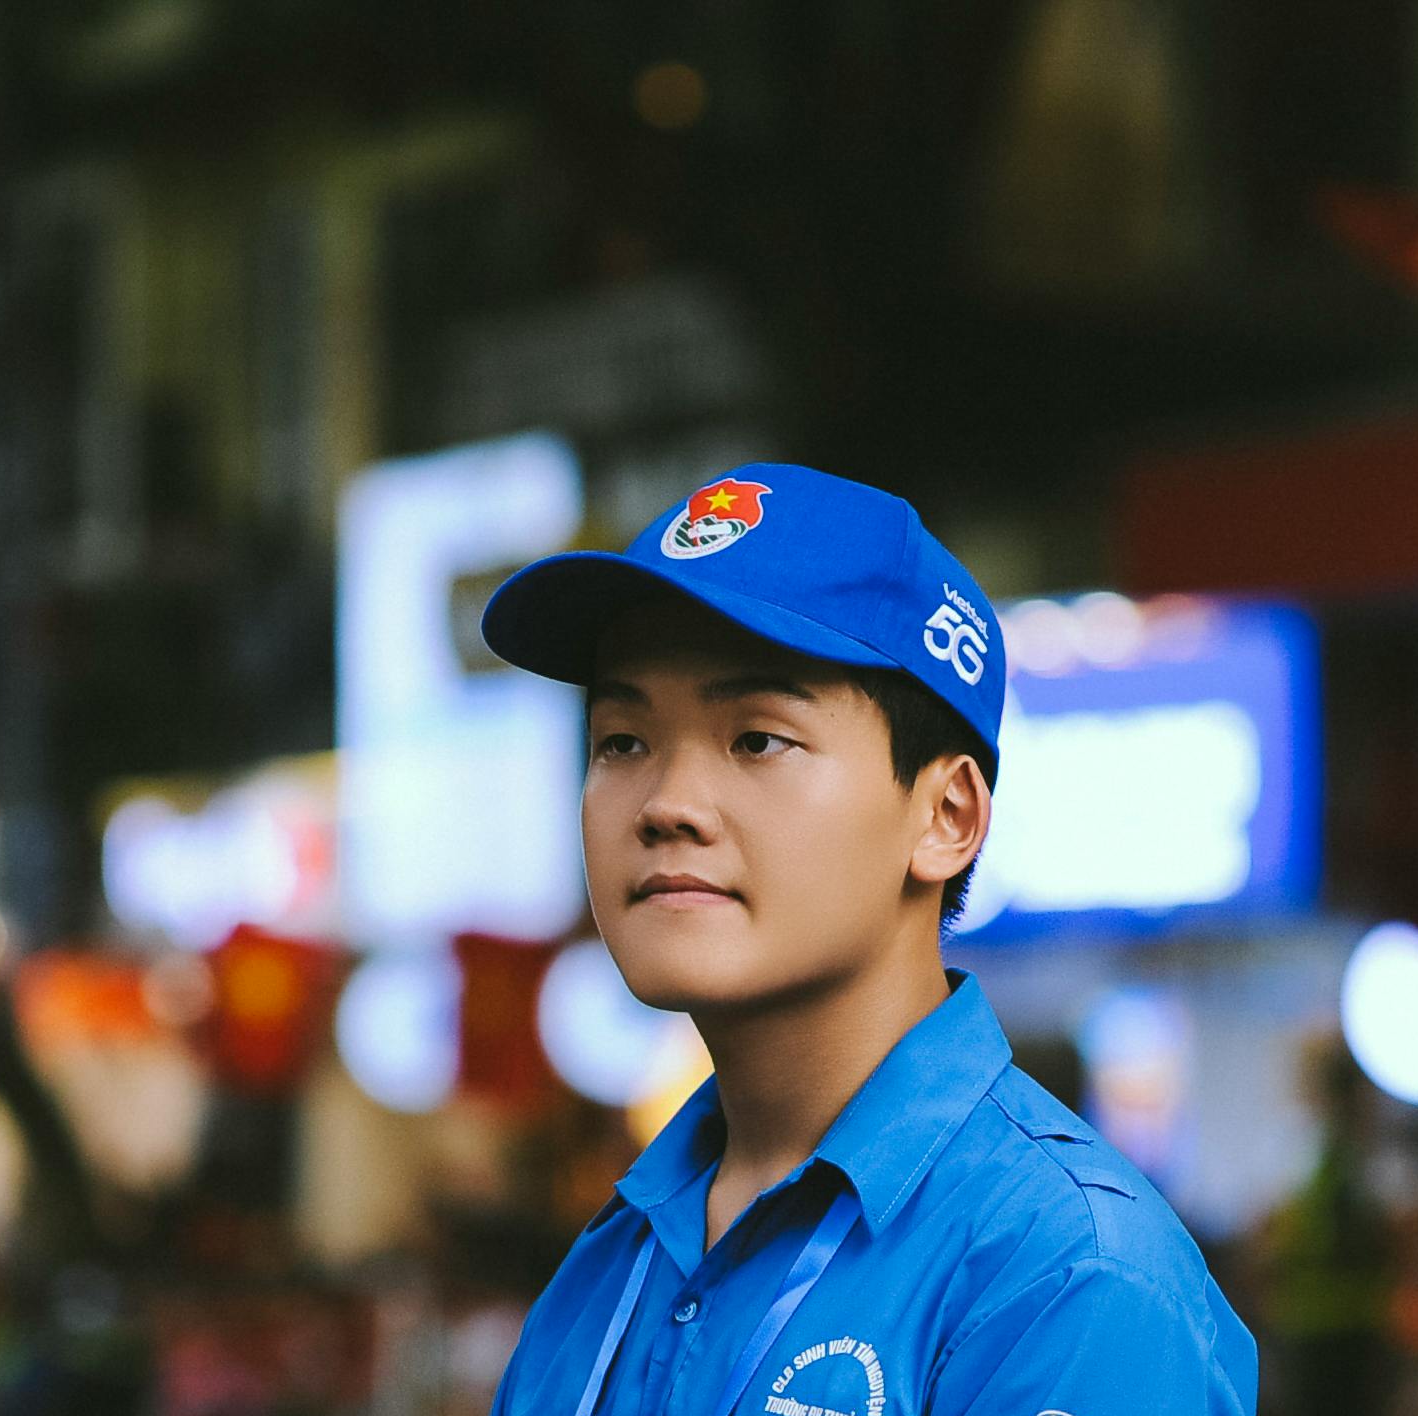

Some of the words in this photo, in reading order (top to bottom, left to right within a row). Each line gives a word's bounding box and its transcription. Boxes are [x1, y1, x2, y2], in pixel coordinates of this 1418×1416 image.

[924, 604, 988, 686] 5G
[772, 1366, 794, 1393] CLB
[793, 1343, 826, 1370] SINH
